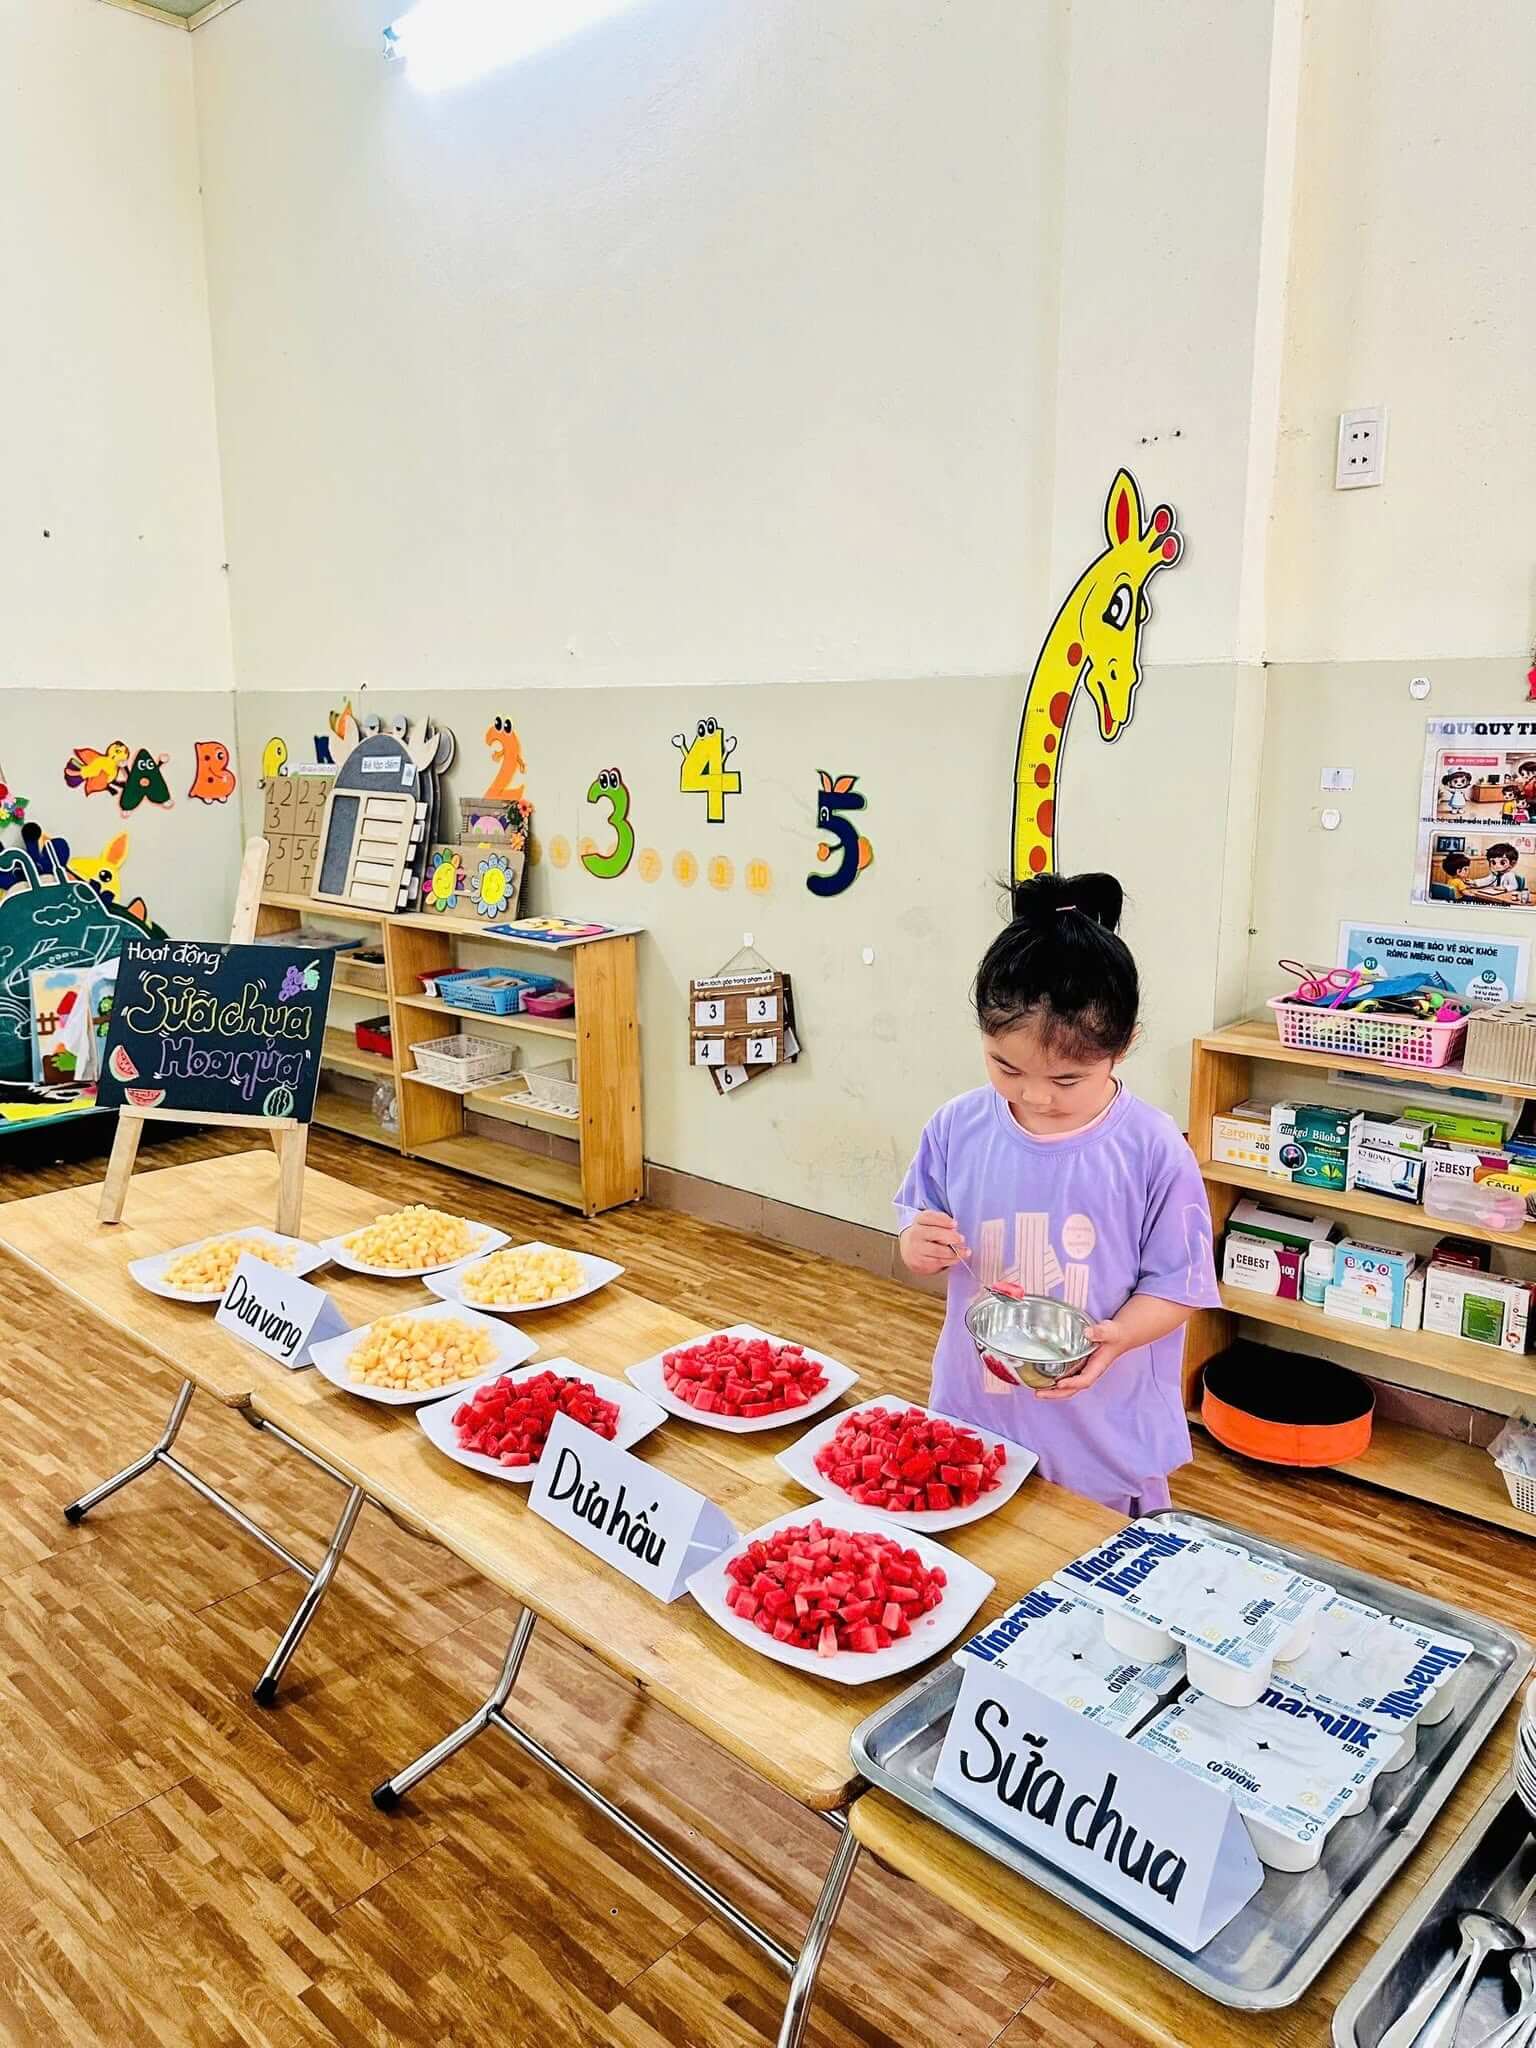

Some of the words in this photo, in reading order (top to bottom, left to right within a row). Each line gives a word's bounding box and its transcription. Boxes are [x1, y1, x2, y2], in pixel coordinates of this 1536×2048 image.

[1475, 722, 1515, 736] QUY
[119, 747, 171, 811] A
[188, 740, 237, 802] B
[484, 718, 525, 800] 2
[680, 722, 742, 824] 4
[580, 770, 635, 880] 3
[806, 790, 867, 897] 5
[127, 941, 171, 964] Hoạt
[172, 943, 221, 975] động
[1366, 936, 1373, 944] 6
[1456, 956, 1474, 966] CON
[1364, 958, 1376, 968] 01
[1483, 972, 1495, 982] 02
[126, 974, 218, 1034] Sữa
[218, 982, 313, 1040] chua
[709, 1004, 717, 1019] 3
[758, 1000, 767, 1016] 3
[158, 1036, 235, 1080] Hoa
[701, 1043, 709, 1058] 4
[754, 1042, 763, 1058] 2
[724, 1069, 733, 1085] 6
[1255, 1141, 1270, 1151] 200
[1312, 1129, 1342, 1144] Biloba
[1236, 1253, 1270, 1270] CEBEST
[224, 1273, 260, 1324] Dưa
[257, 1301, 303, 1358] vàng
[548, 1447, 609, 1529] Dưa
[606, 1484, 669, 1568] hấu
[1063, 1523, 1157, 1584] Vinamilk
[1095, 1531, 1193, 1598] Vinamilk
[961, 1588, 1065, 1663] Vinamilk
[1372, 1644, 1468, 1721] Vinamilk
[1257, 1687, 1378, 1750] namilk
[1341, 1742, 1367, 1758] 1976
[1337, 1787, 1353, 1800] 10
[1351, 1773, 1366, 1785] 10
[959, 1698, 1066, 1827] Sữa
[1064, 1772, 1188, 1905] chua
